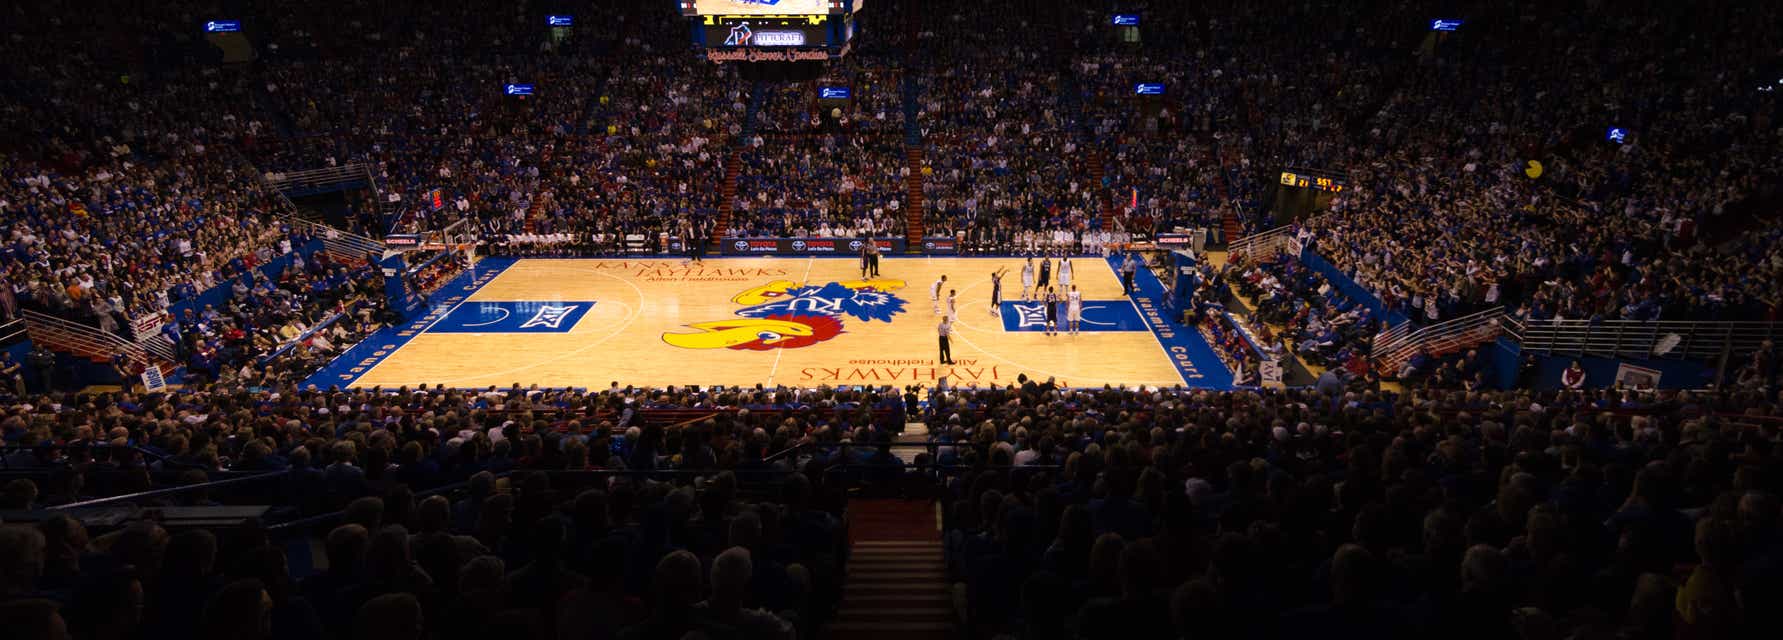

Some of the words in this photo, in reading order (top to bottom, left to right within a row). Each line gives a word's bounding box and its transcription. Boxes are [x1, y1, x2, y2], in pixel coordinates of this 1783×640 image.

[635, 268, 786, 277] JAYHAWKS
[339, 344, 396, 381] James
[801, 367, 999, 380] JAYHAWKS
[1171, 346, 1204, 379] Court
